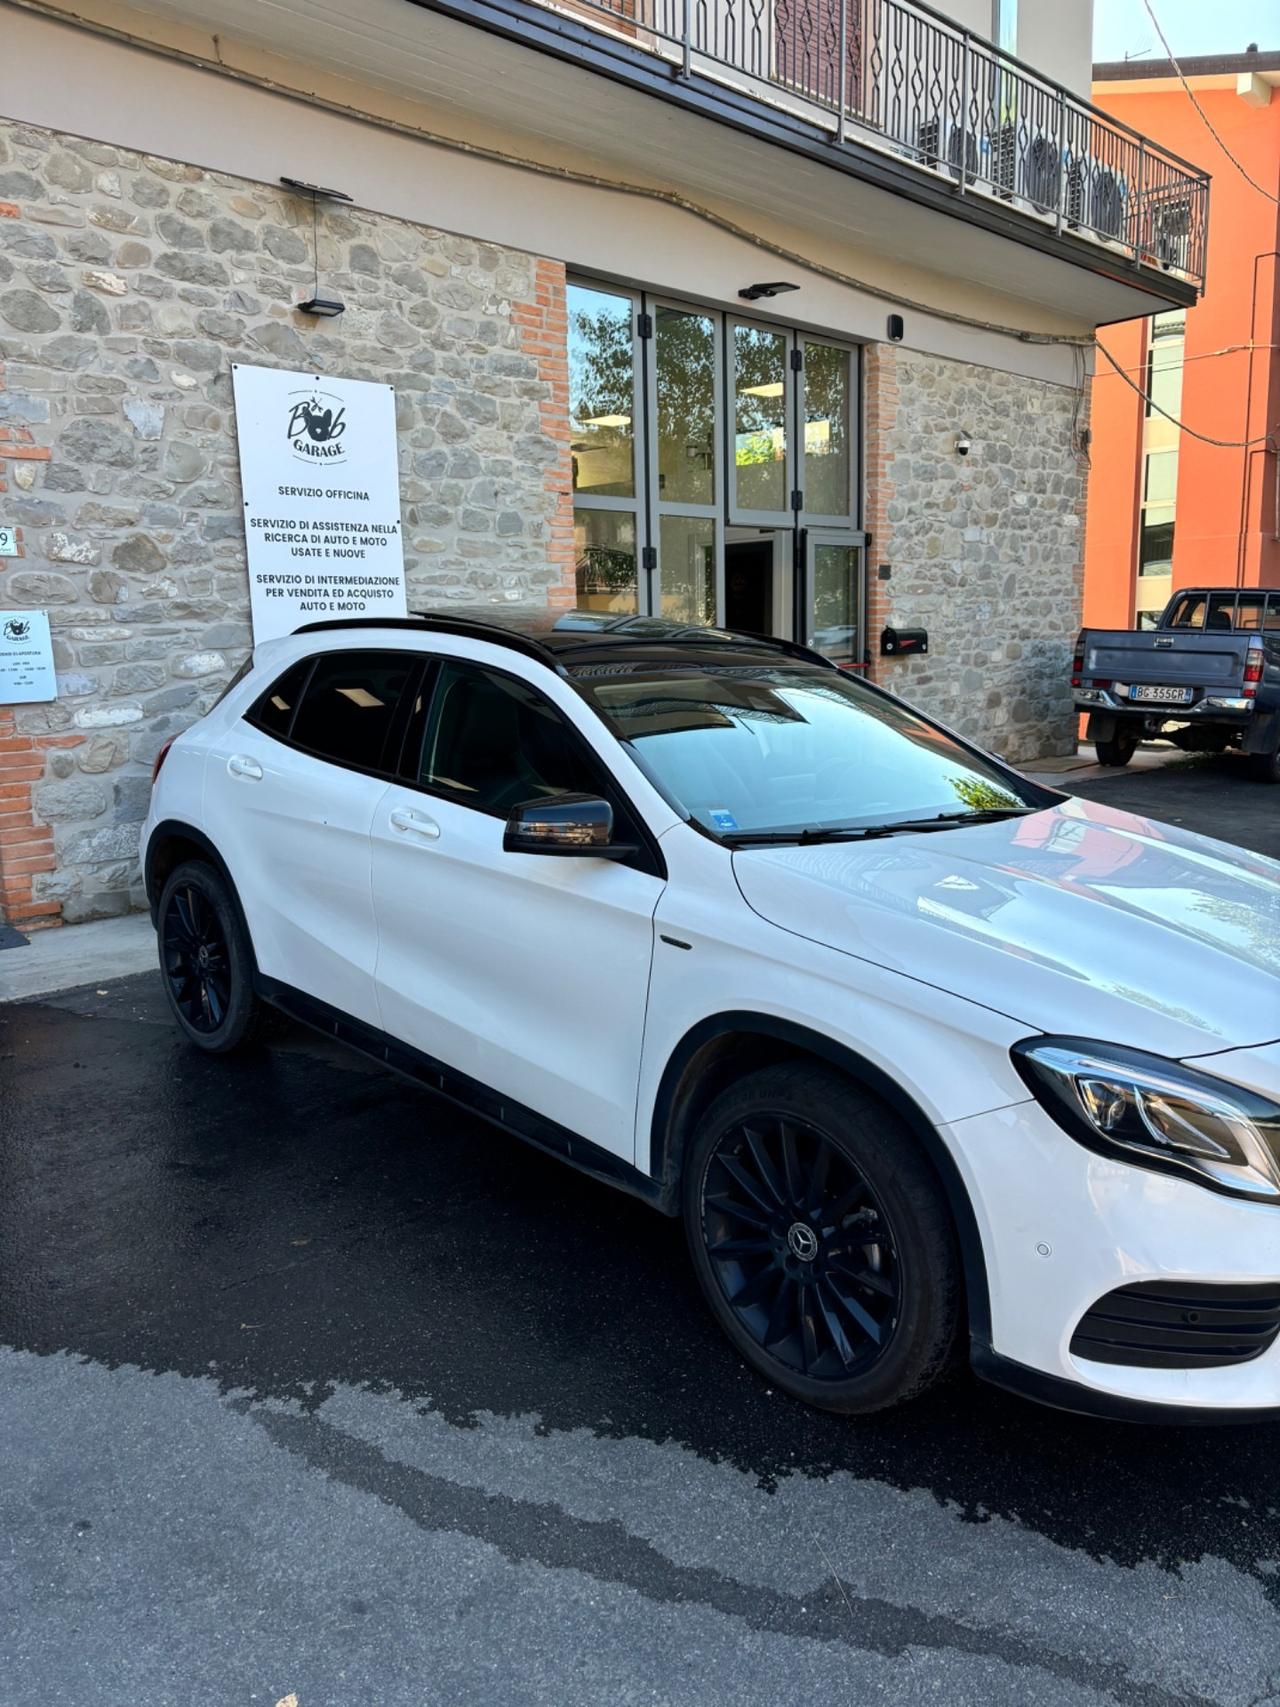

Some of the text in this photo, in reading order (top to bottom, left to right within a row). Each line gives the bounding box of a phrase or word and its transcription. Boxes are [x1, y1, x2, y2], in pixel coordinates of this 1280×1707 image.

[293, 439, 346, 457] GARAGE
[278, 486, 370, 501] SERVIZIO OFFICINA
[250, 518, 398, 534] SERVIZIO DI ASSISTENZA NELLA
[264, 533, 388, 546] RICERCA DI AUTO E MOTO
[291, 547, 366, 559] USATE E NUOVE
[256, 574, 400, 586] SERVIZIO DI INTERMEDIAZIONE
[265, 588, 394, 599] PER VENDITA ED ACQUISTO
[300, 602, 366, 611] AUTO E MOTO
